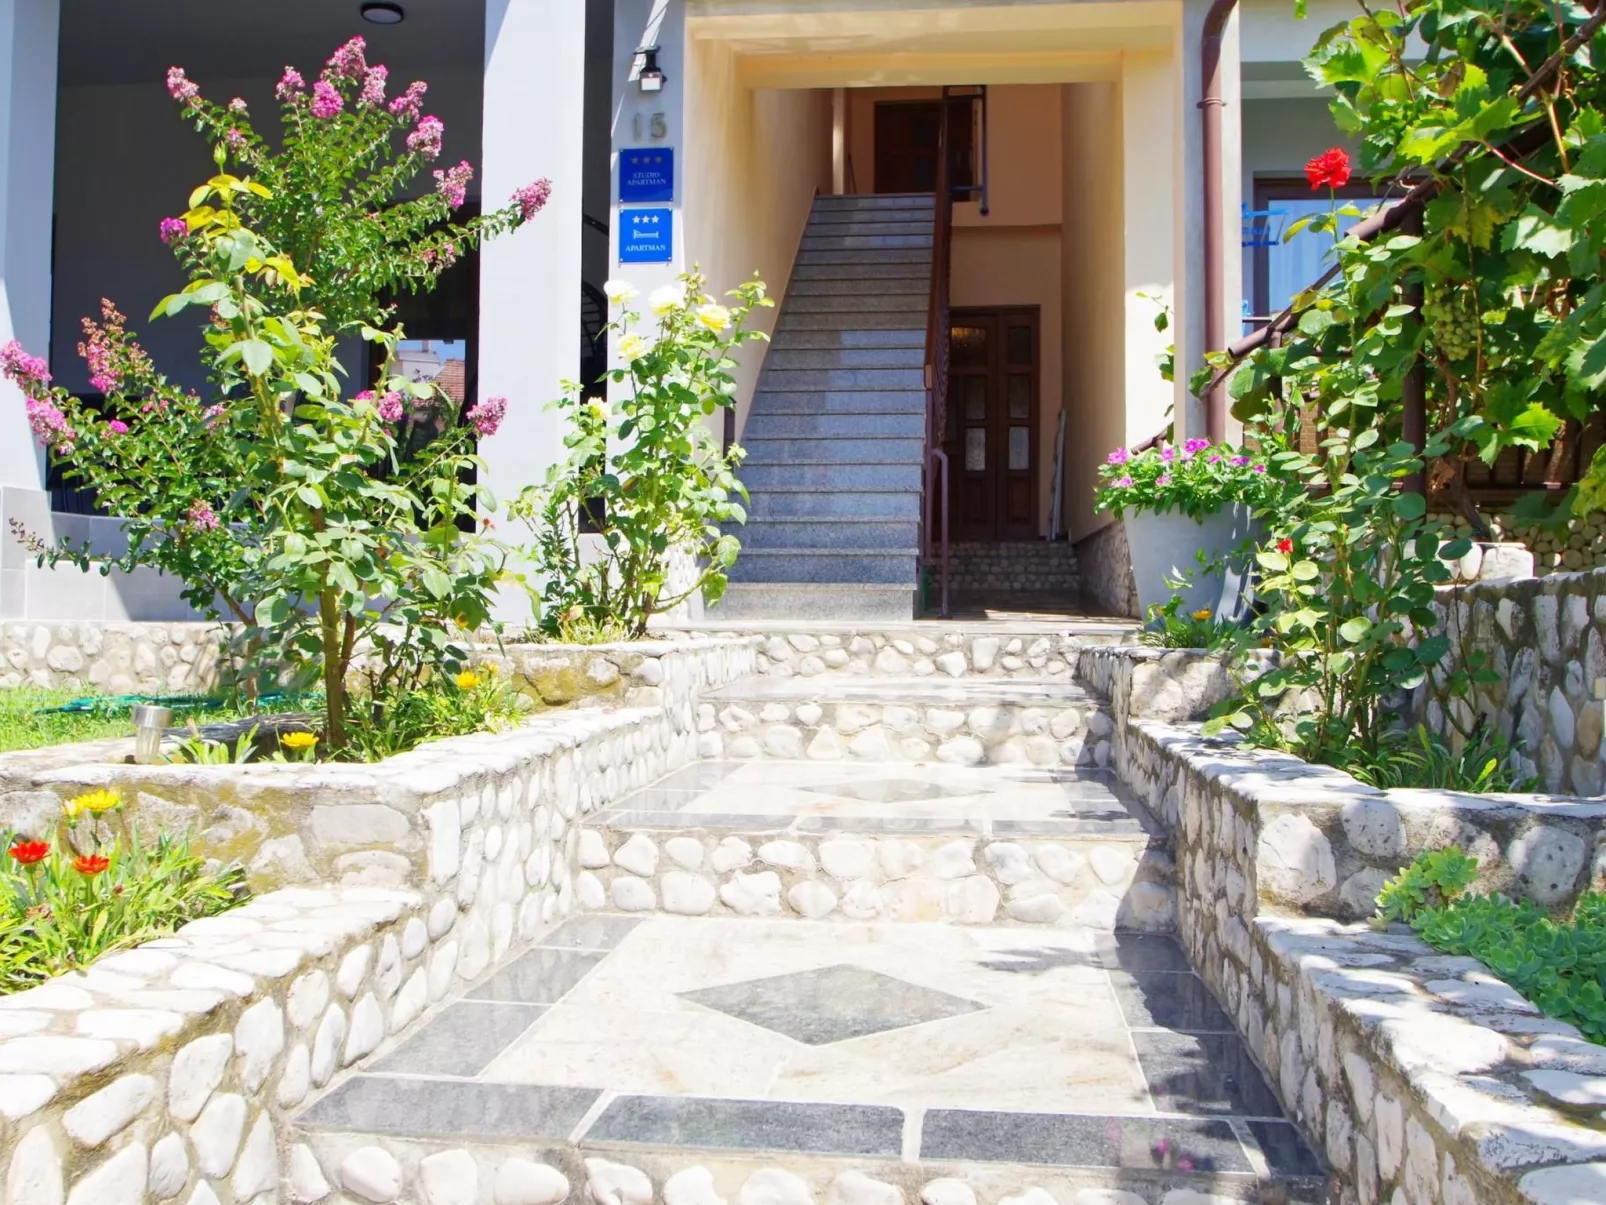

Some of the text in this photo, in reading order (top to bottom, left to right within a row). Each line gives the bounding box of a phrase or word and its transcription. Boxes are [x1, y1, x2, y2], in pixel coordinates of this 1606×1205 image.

[632, 112, 668, 141] 15
[626, 178, 666, 186] APARTMAN
[625, 244, 666, 252] APARTMAN
